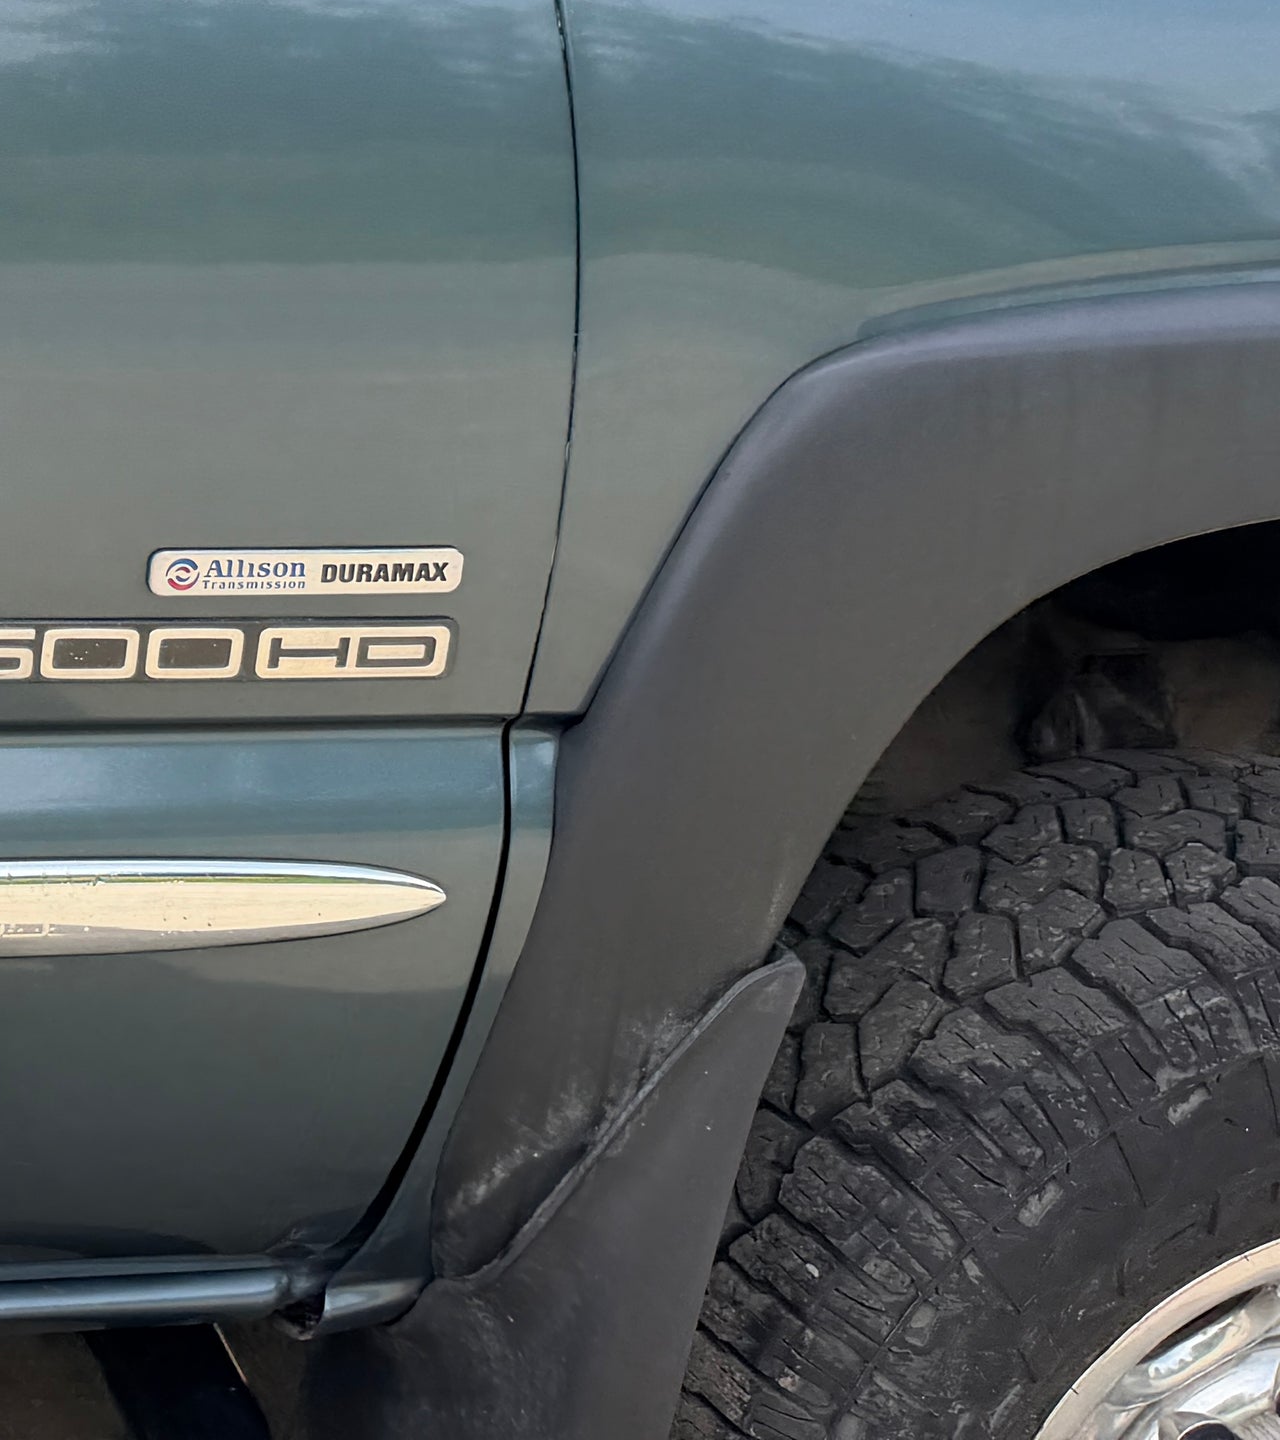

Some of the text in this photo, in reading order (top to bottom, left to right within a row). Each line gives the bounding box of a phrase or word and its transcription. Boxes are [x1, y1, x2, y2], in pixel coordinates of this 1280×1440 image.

[204, 559, 449, 583] Allison DURAMAX
[202, 579, 306, 590] Transmission
